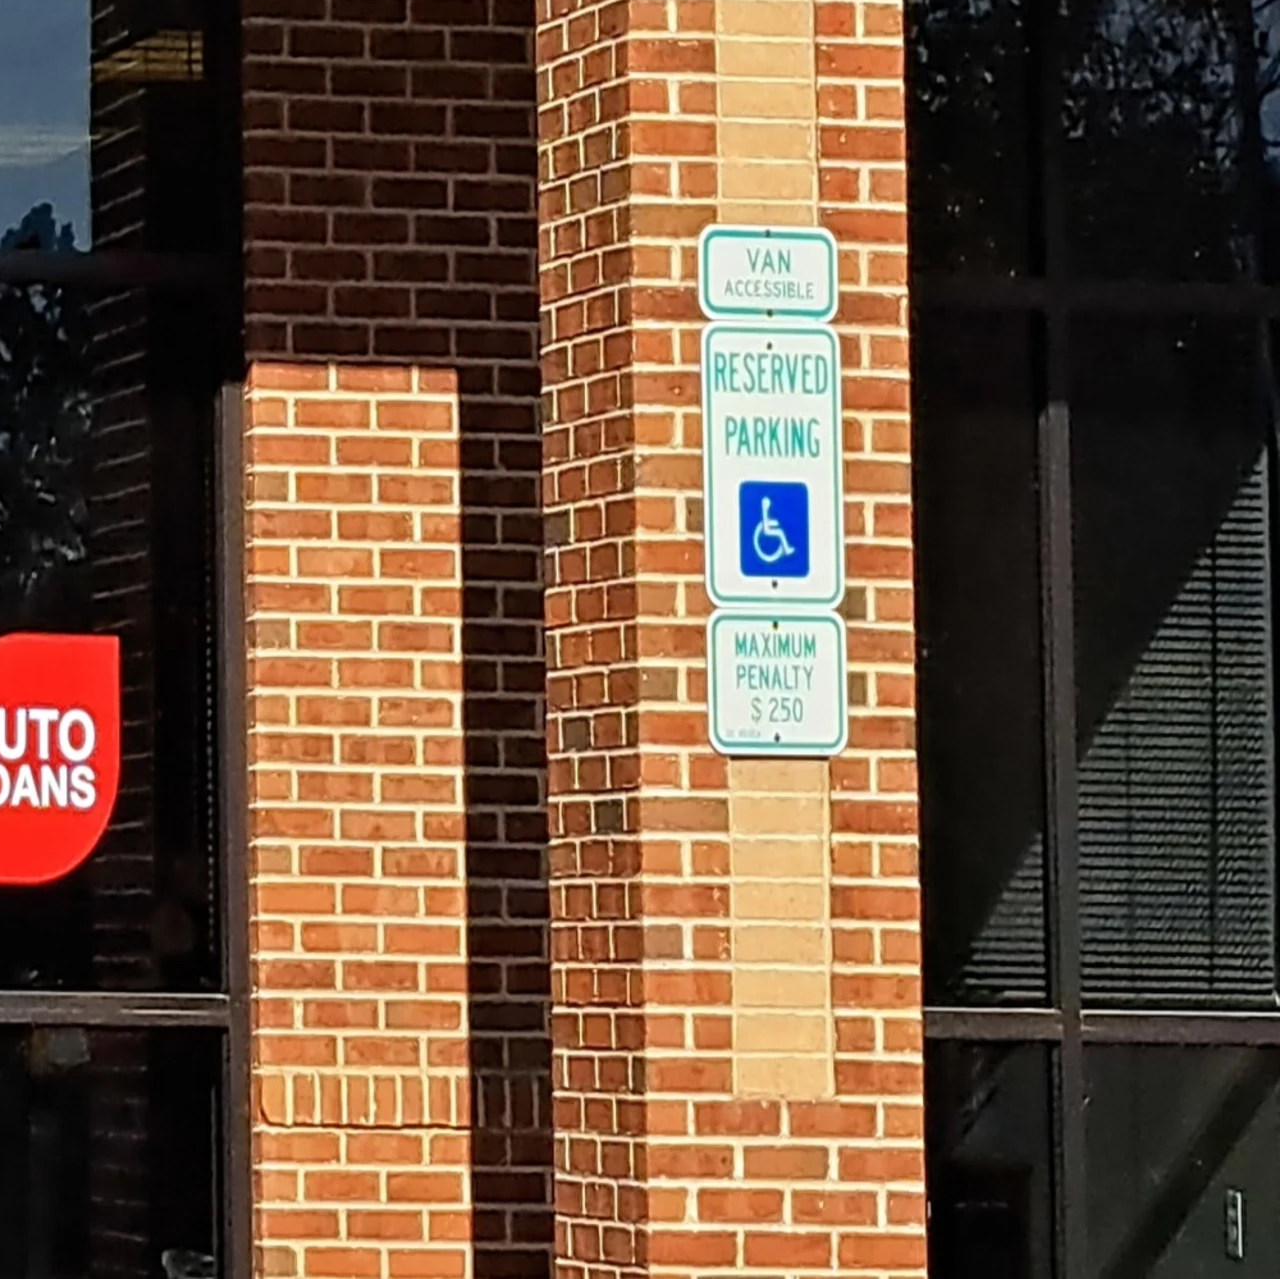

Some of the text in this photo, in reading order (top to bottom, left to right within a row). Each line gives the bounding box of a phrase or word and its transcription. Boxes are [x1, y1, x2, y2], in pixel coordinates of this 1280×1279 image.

[746, 247, 792, 274] VAN
[724, 280, 815, 300] ACCESSIBLE
[714, 352, 829, 395] RESERVED
[725, 416, 821, 458] PARKING
[734, 633, 817, 659] MAXIMUM
[735, 665, 815, 691] PENALTY
